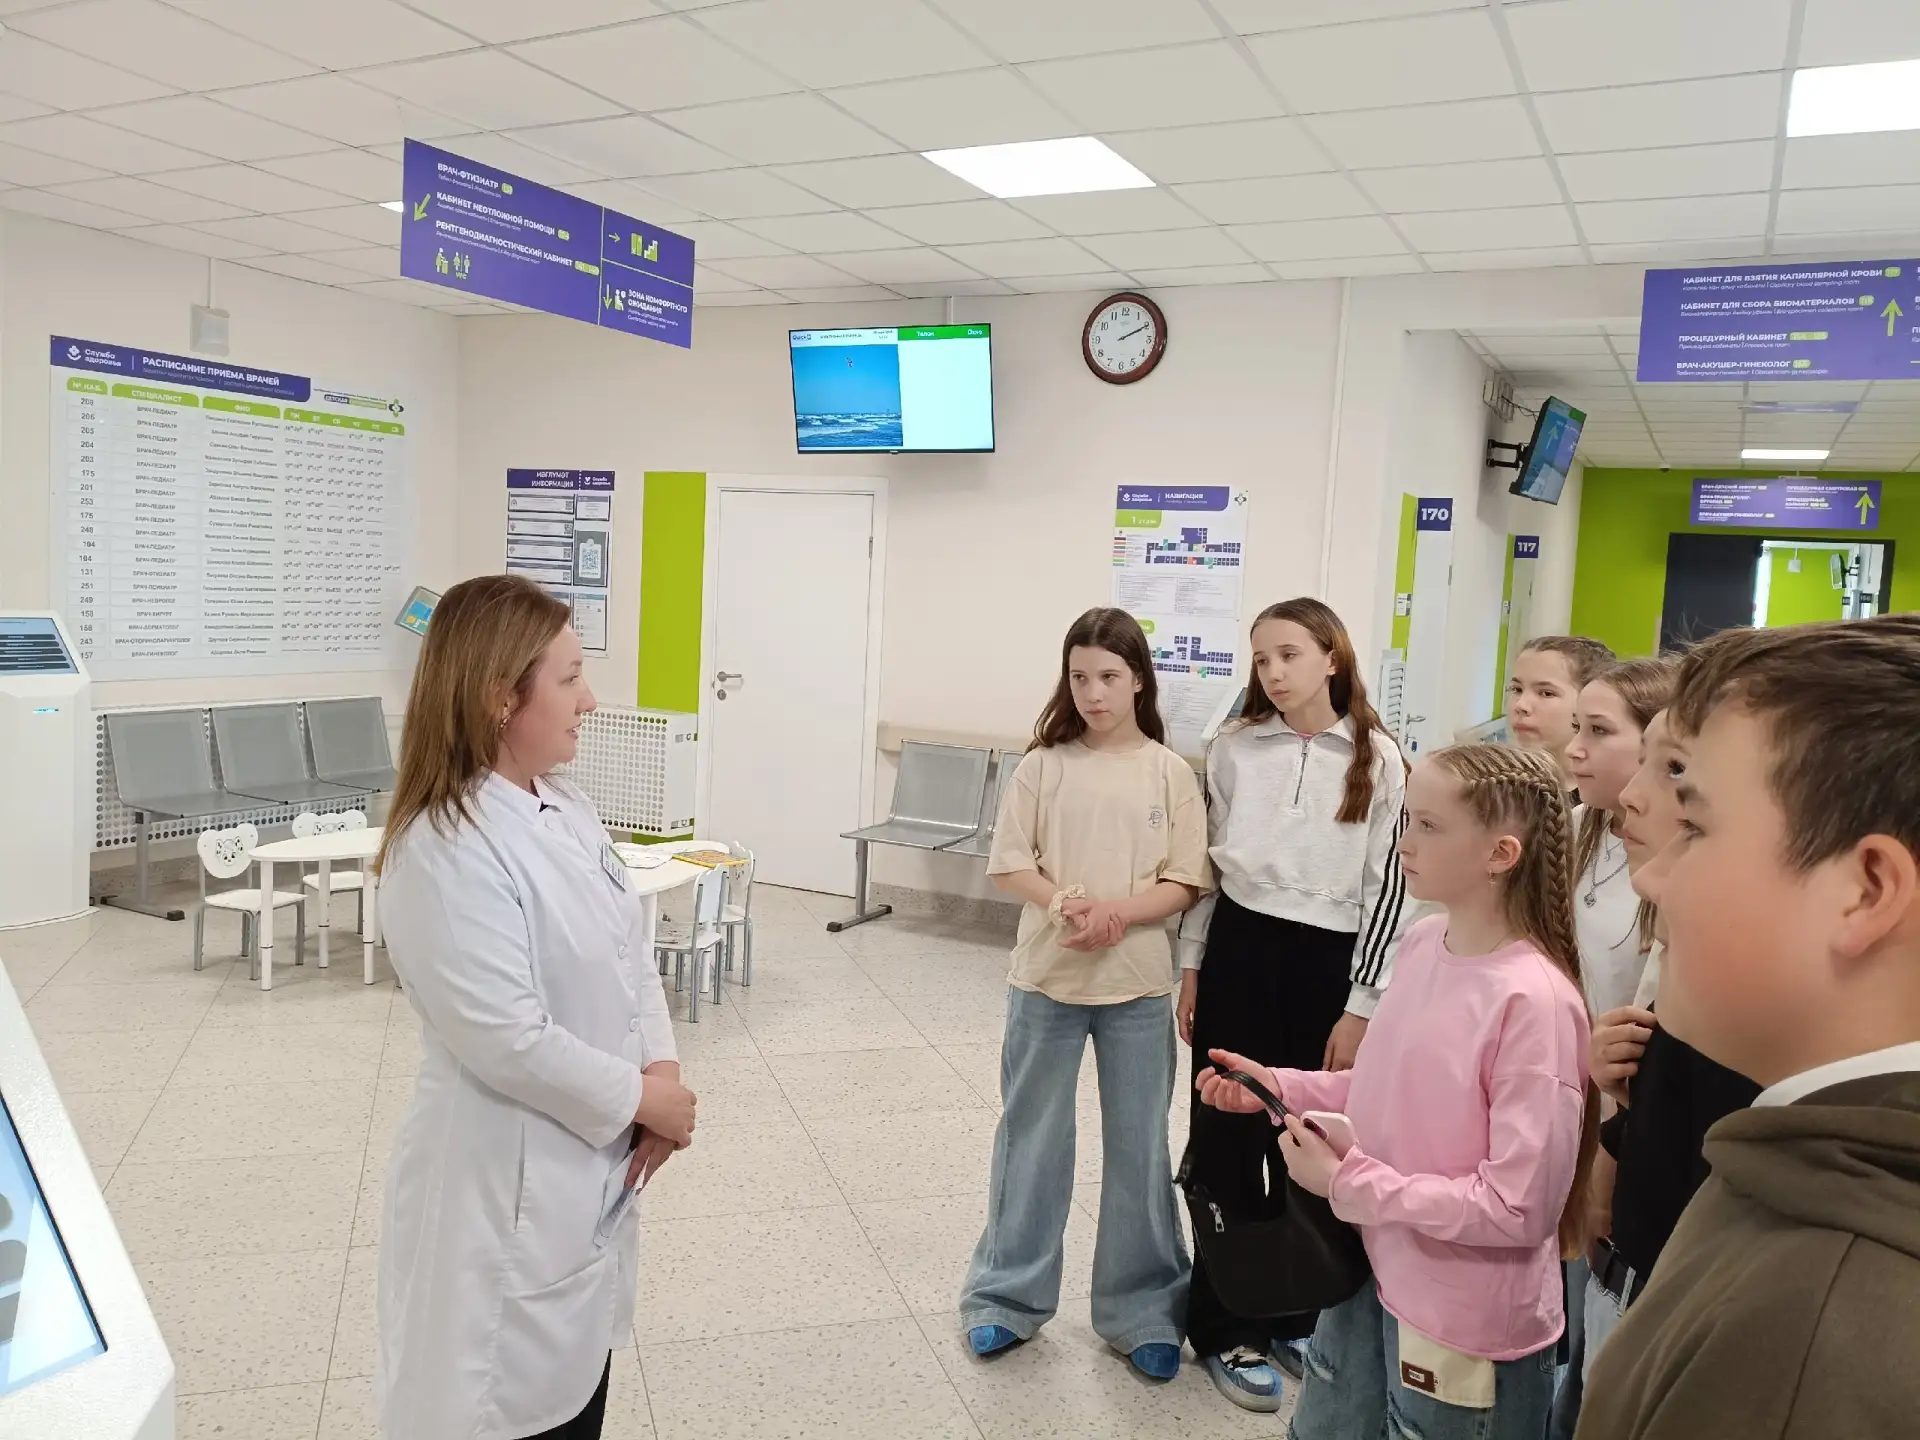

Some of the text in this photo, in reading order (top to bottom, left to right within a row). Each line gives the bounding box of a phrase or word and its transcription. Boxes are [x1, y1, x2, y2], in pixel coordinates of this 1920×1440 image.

[437, 162, 499, 189] ВРАЧ-ФТИЗИАТР
[436, 191, 472, 208] КАБИНЕТ
[472, 203, 523, 225] НЕОТЛОЖНОЙ
[523, 219, 555, 235] ПОМОЩИ
[436, 220, 542, 257] РЕНТГЕНОДИАГНОСТИЧЕСКИЙ
[543, 252, 573, 266] КАБИНЕТ
[455, 272, 467, 280] WC
[1683, 276, 1722, 284] КАБИНЕТ
[1724, 275, 1742, 283] ДЛЯ
[1780, 270, 1849, 281] КАПИЛЛЯРНОЙ
[1851, 269, 1883, 277] КРОВИ
[628, 289, 688, 313] ЗОНА КОМФОРТНОГО
[1681, 302, 1720, 310] КАБИНЕТ
[1722, 301, 1740, 310] ДЛЯ
[1742, 300, 1772, 308] СБОРА
[1773, 298, 1855, 307] БИОМАТЕРИАЛОВ
[628, 299, 662, 314] ОЖИДАНИЯ
[1121, 307, 1130, 316] 12
[1111, 311, 1118, 321] 11
[1100, 321, 1108, 331] 10
[1144, 321, 1150, 330] 2
[1095, 336, 1101, 344] 9
[1145, 335, 1152, 344] 3
[1679, 333, 1745, 343] ПРОЦЕДУРНЫЙ
[1747, 333, 1787, 341] КАБИНЕТ
[84, 348, 116, 359] Служба
[1097, 348, 1104, 357] 8
[1139, 349, 1145, 357] 4
[1107, 358, 1113, 367] 7
[1118, 361, 1124, 370] 6
[1129, 358, 1136, 367] 5
[1676, 360, 1791, 369] ВРАЧ-АКУШЕР-ГИНЕКОЛОГ
[142, 356, 206, 375] РАСПИСАНИЕ
[207, 367, 245, 381] ПРИЕМА
[246, 373, 280, 386] ВРАЧЕЙ
[131, 390, 182, 403] СПЕЦИАЛИСТ
[136, 405, 178, 416] ВРАЧ-ПЕДИАТР
[80, 412, 96, 421] 206
[136, 419, 178, 429] ВРАЧ-ПЕДИАТР
[80, 426, 178, 443] 205 ВРАЧ-ПЕДИАТР
[80, 440, 94, 449] 204
[136, 447, 177, 457] ВРАЧ-ПЕДИАТР
[80, 455, 177, 470] 203 ВРАЧ-ПЕДИАТР
[81, 469, 95, 478] 175
[531, 480, 574, 488] ИНФОРМАЦИЯ
[80, 483, 176, 497] 201 ВРАЧ-ПЕДИАТР
[80, 498, 94, 506] 253
[80, 511, 94, 520] 175
[1421, 508, 1449, 521] 170
[135, 529, 176, 537] ВРАЧ-ПЕДИАТР
[1517, 541, 1536, 553] 117
[80, 582, 94, 590] 251
[80, 651, 94, 660] 157
